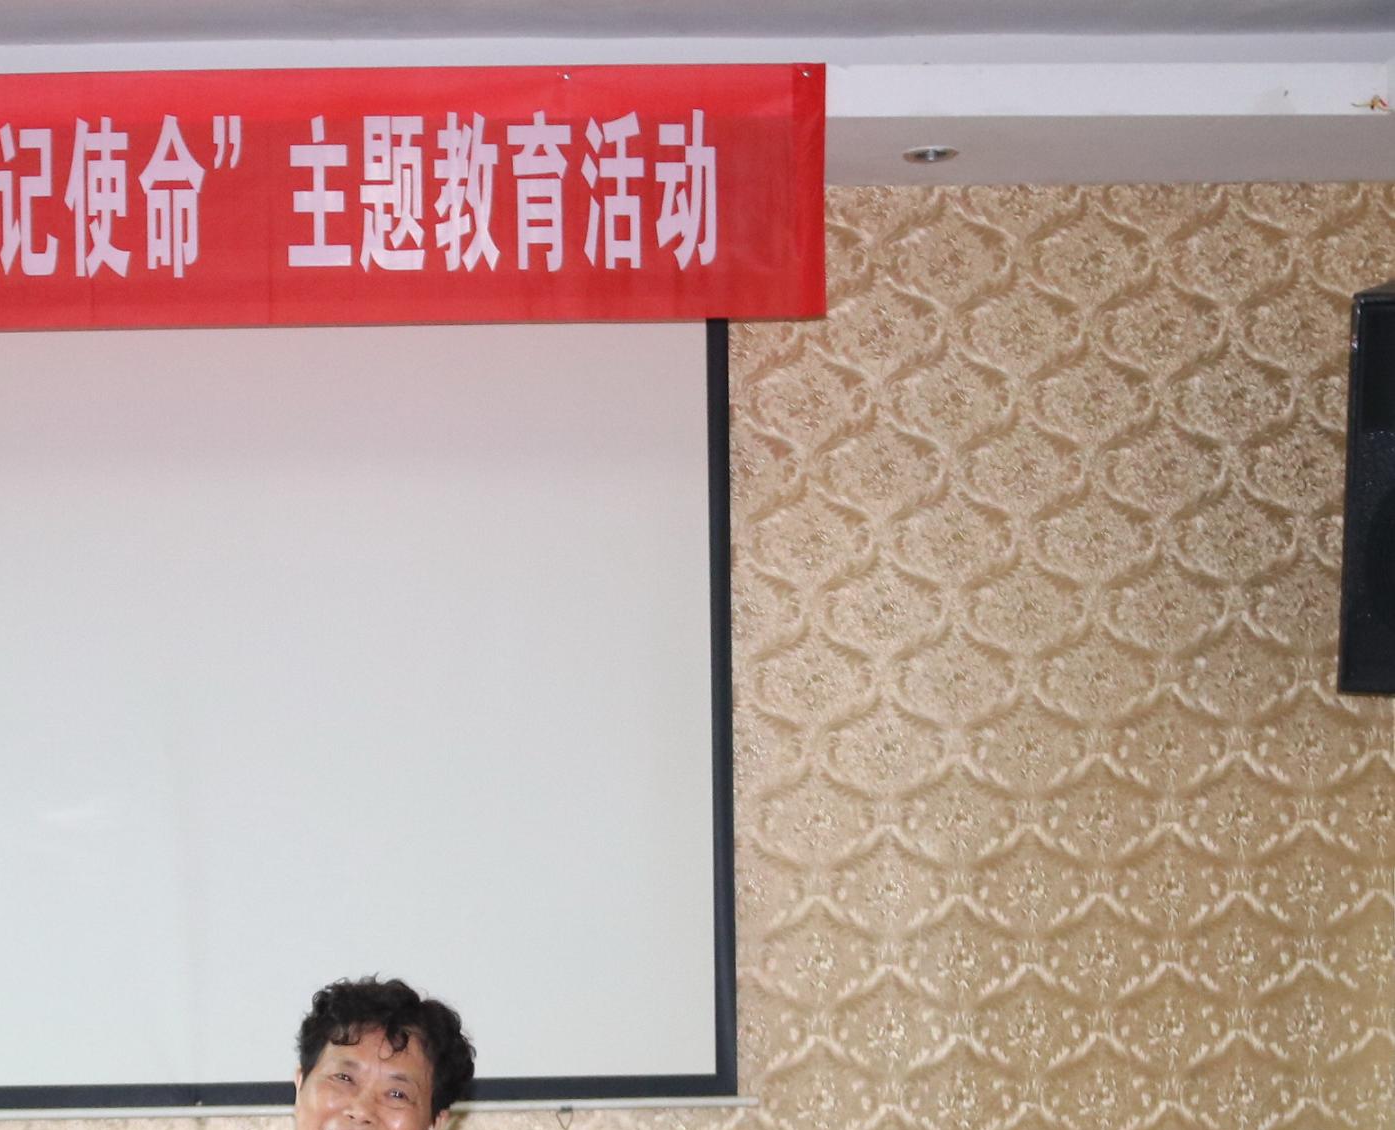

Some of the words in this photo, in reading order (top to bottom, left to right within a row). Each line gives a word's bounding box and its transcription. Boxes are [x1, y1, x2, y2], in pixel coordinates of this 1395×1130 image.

[288, 109, 717, 274] 主题教育活动
